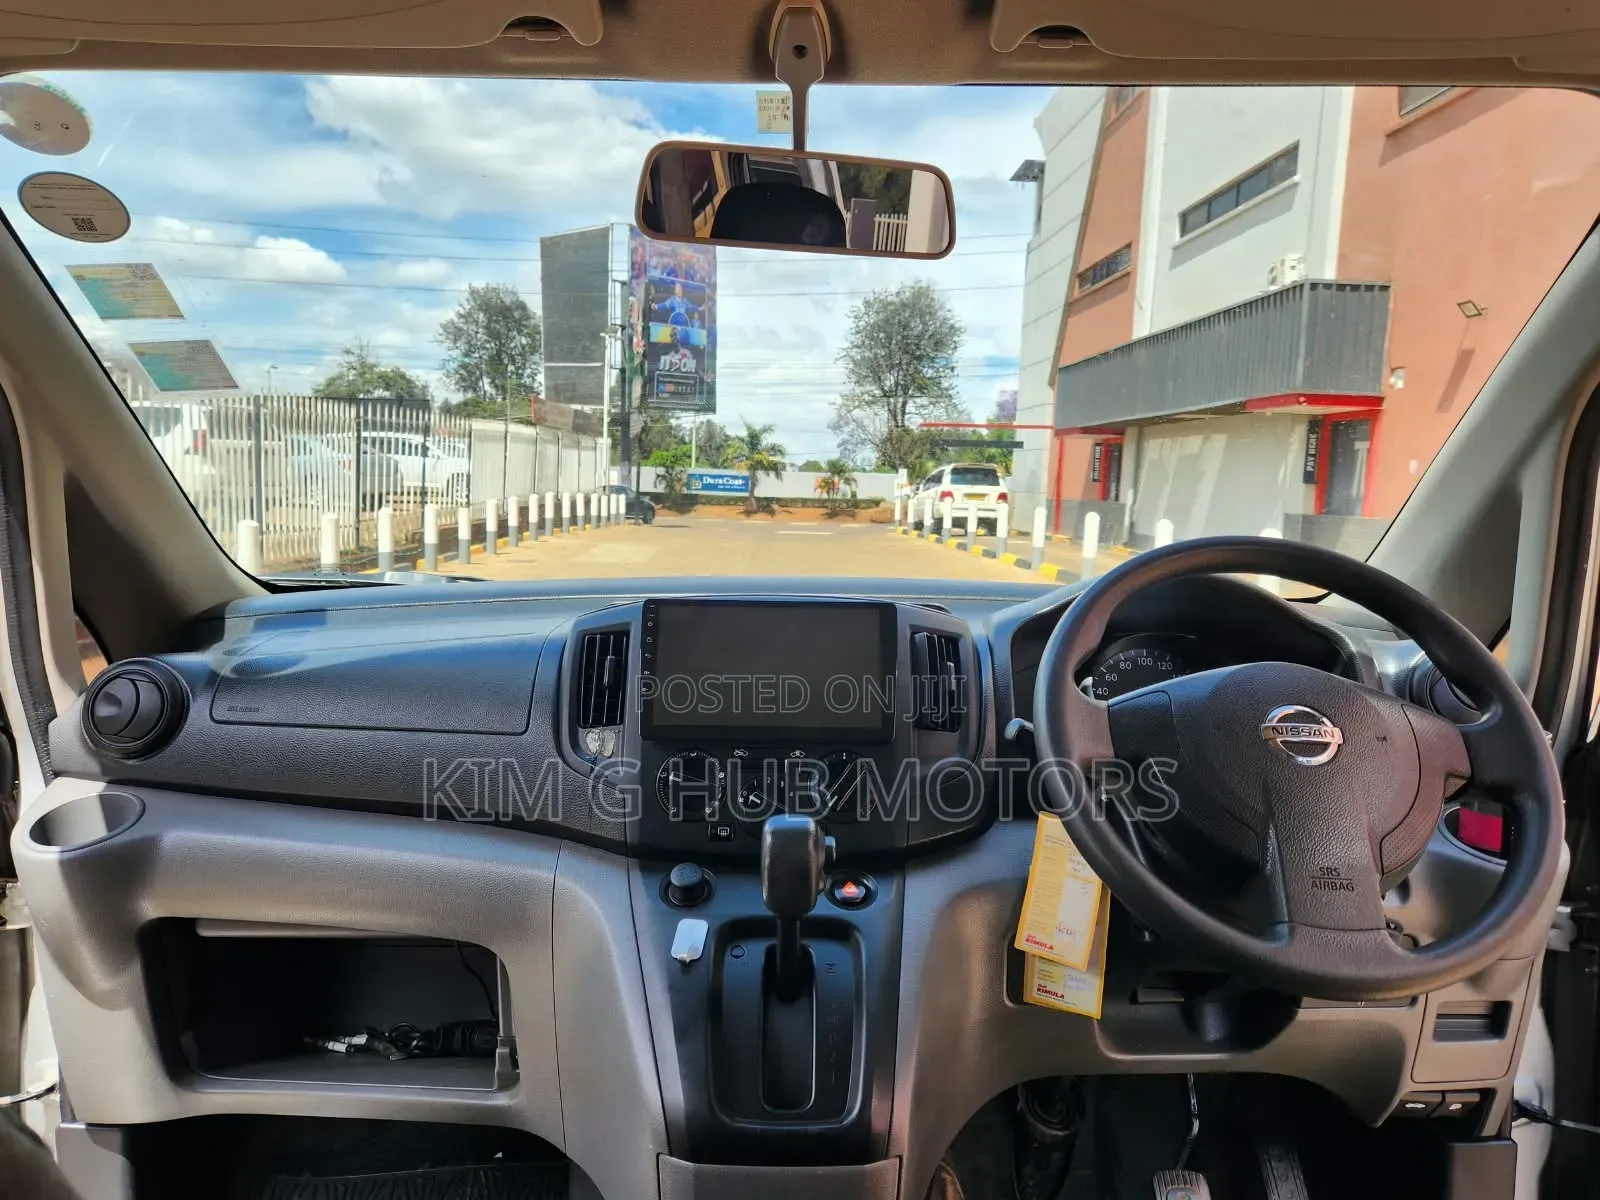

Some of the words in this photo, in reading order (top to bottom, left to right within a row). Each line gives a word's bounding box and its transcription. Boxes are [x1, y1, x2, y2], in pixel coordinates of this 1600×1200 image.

[1307, 433, 1318, 455] HERE
[1306, 456, 1315, 471] PAY
[1119, 661, 1132, 670] 80
[1137, 657, 1153, 666] 100
[1157, 662, 1173, 670] 120
[1105, 673, 1118, 682] 60
[1096, 687, 1109, 696] 40
[1271, 726, 1335, 739] NISSAN
[1319, 866, 1341, 878] SRS
[1310, 879, 1355, 893] AIRBAG
[1025, 937, 1055, 951] RIMULA
[1036, 986, 1065, 1000] RIMULA
